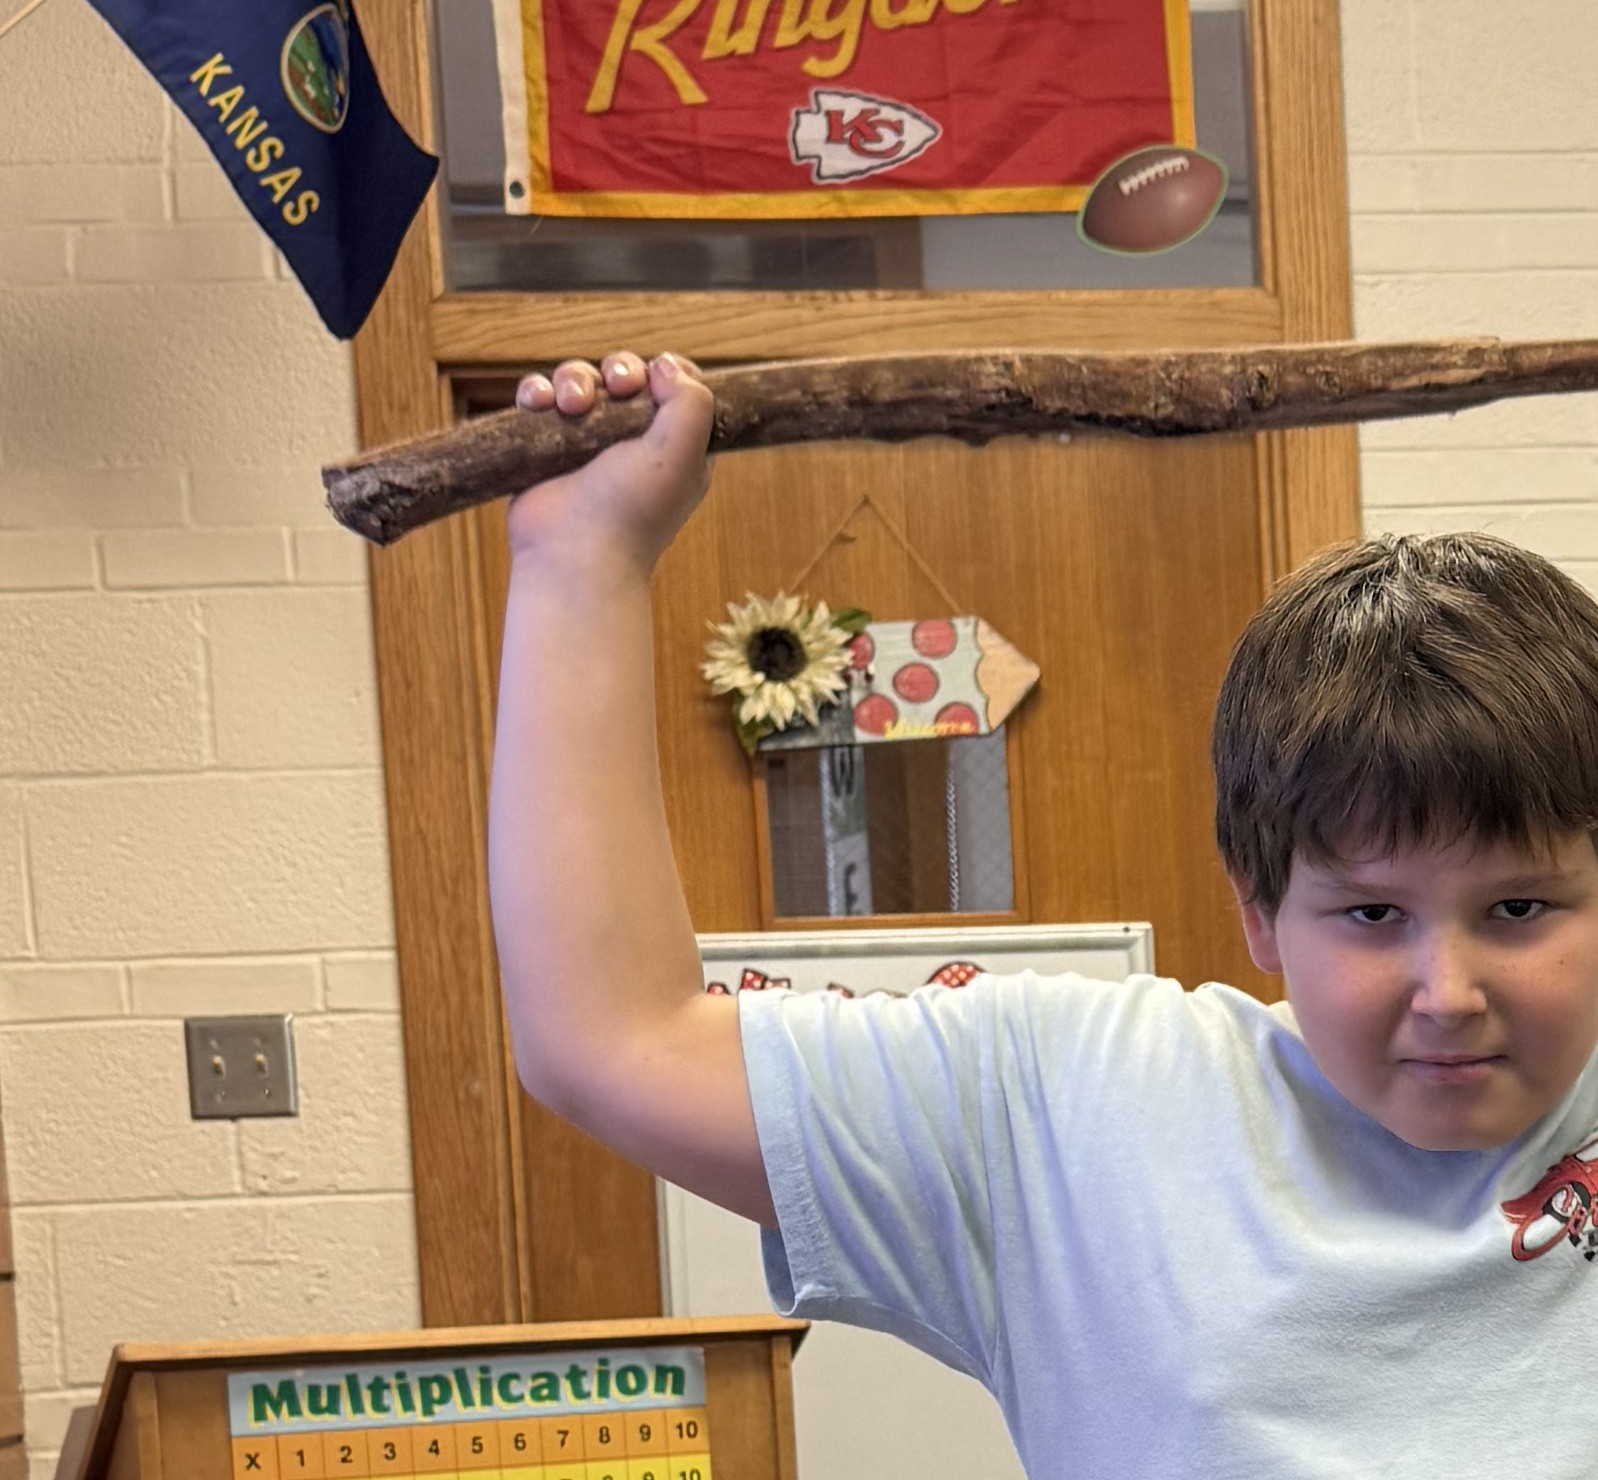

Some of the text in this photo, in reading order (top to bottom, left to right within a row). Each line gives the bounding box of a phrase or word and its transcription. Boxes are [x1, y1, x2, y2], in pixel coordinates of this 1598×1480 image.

[189, 53, 320, 225] KANSAS
[823, 108, 906, 159] KC
[249, 1357, 687, 1423] Multiplication
[296, 1450, 305, 1466] 1
[340, 1446, 352, 1464] 2
[384, 1442, 396, 1460] 3
[428, 1439, 440, 1456] 4
[472, 1436, 483, 1454] 5
[514, 1433, 526, 1451] 6
[557, 1430, 569, 1447] 7
[598, 1426, 610, 1444] 8
[639, 1424, 651, 1442] 9
[676, 1422, 698, 1438] 10
